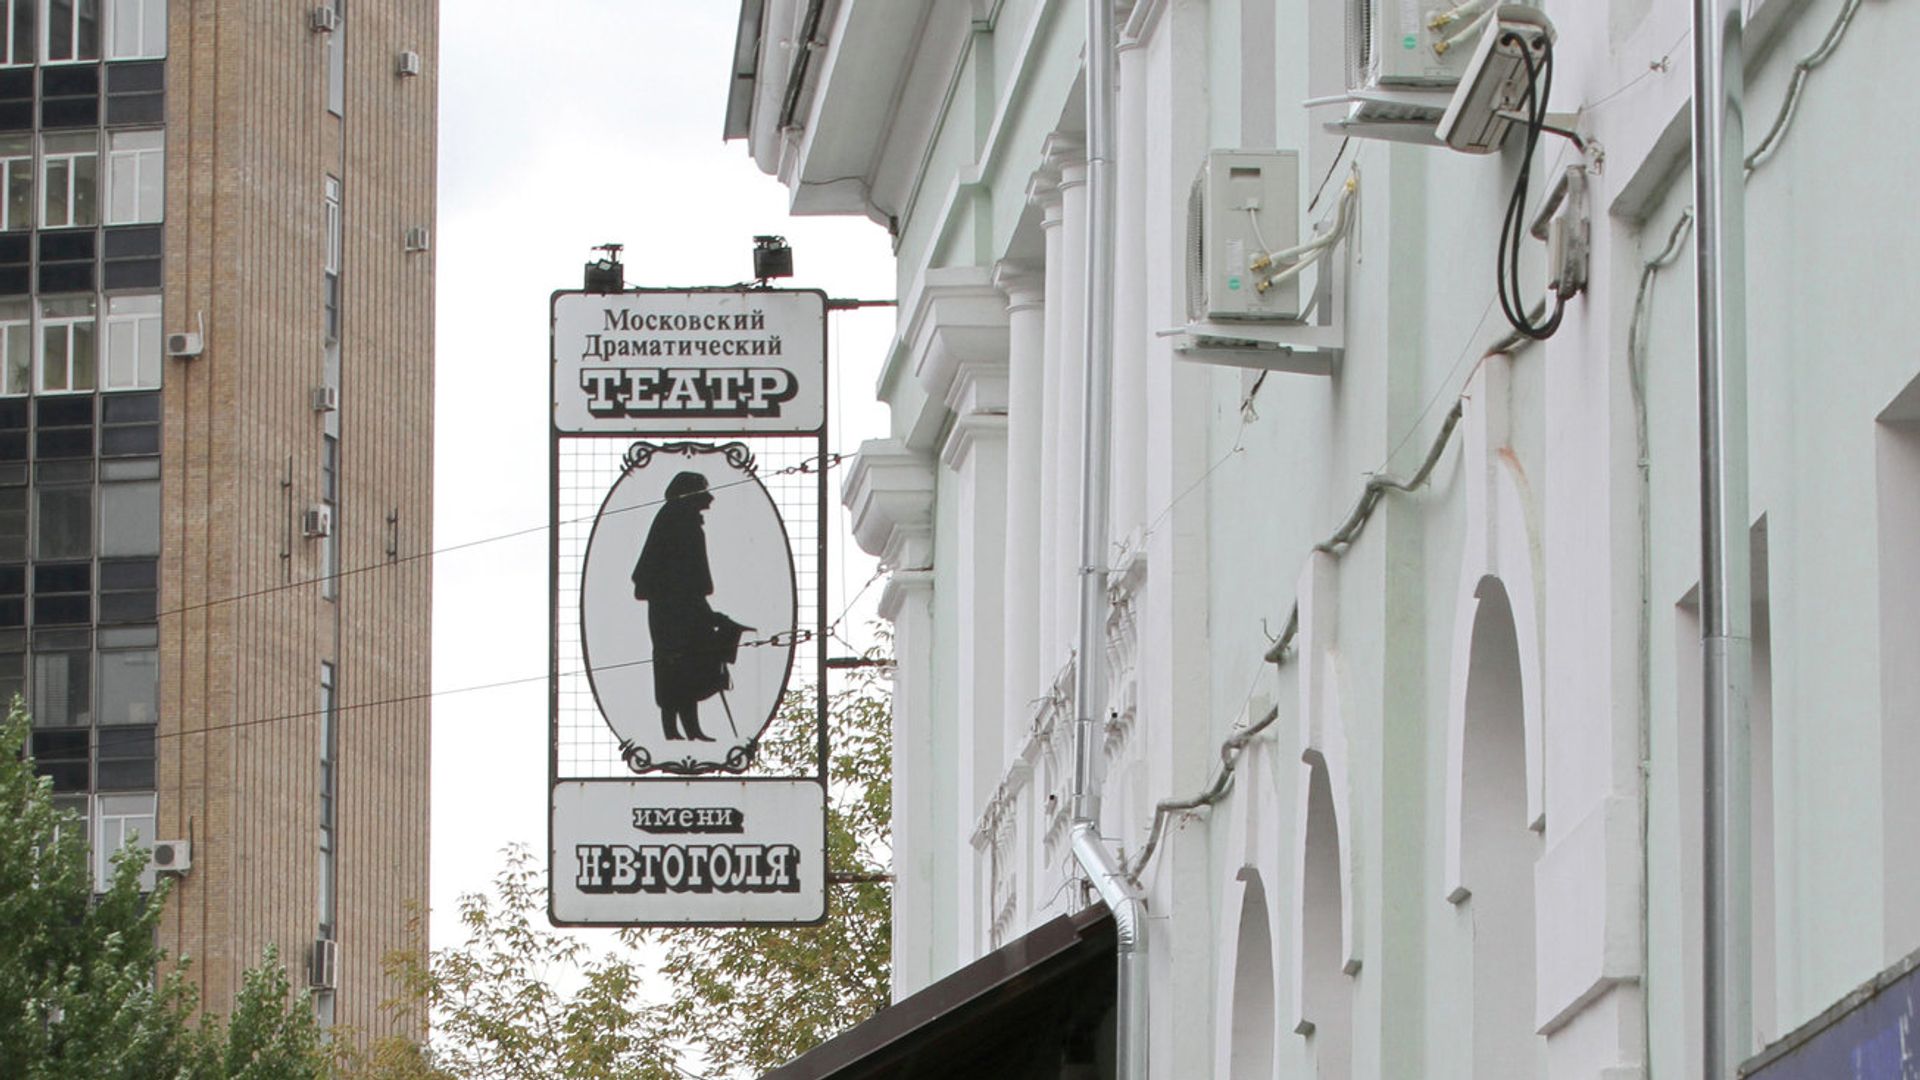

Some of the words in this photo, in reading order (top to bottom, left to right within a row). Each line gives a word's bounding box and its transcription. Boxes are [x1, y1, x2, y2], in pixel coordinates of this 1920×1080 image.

[603, 309, 765, 331] Московский
[582, 334, 782, 361] Драматический
[580, 367, 799, 418] ТЕАТР
[633, 808, 744, 834] имени
